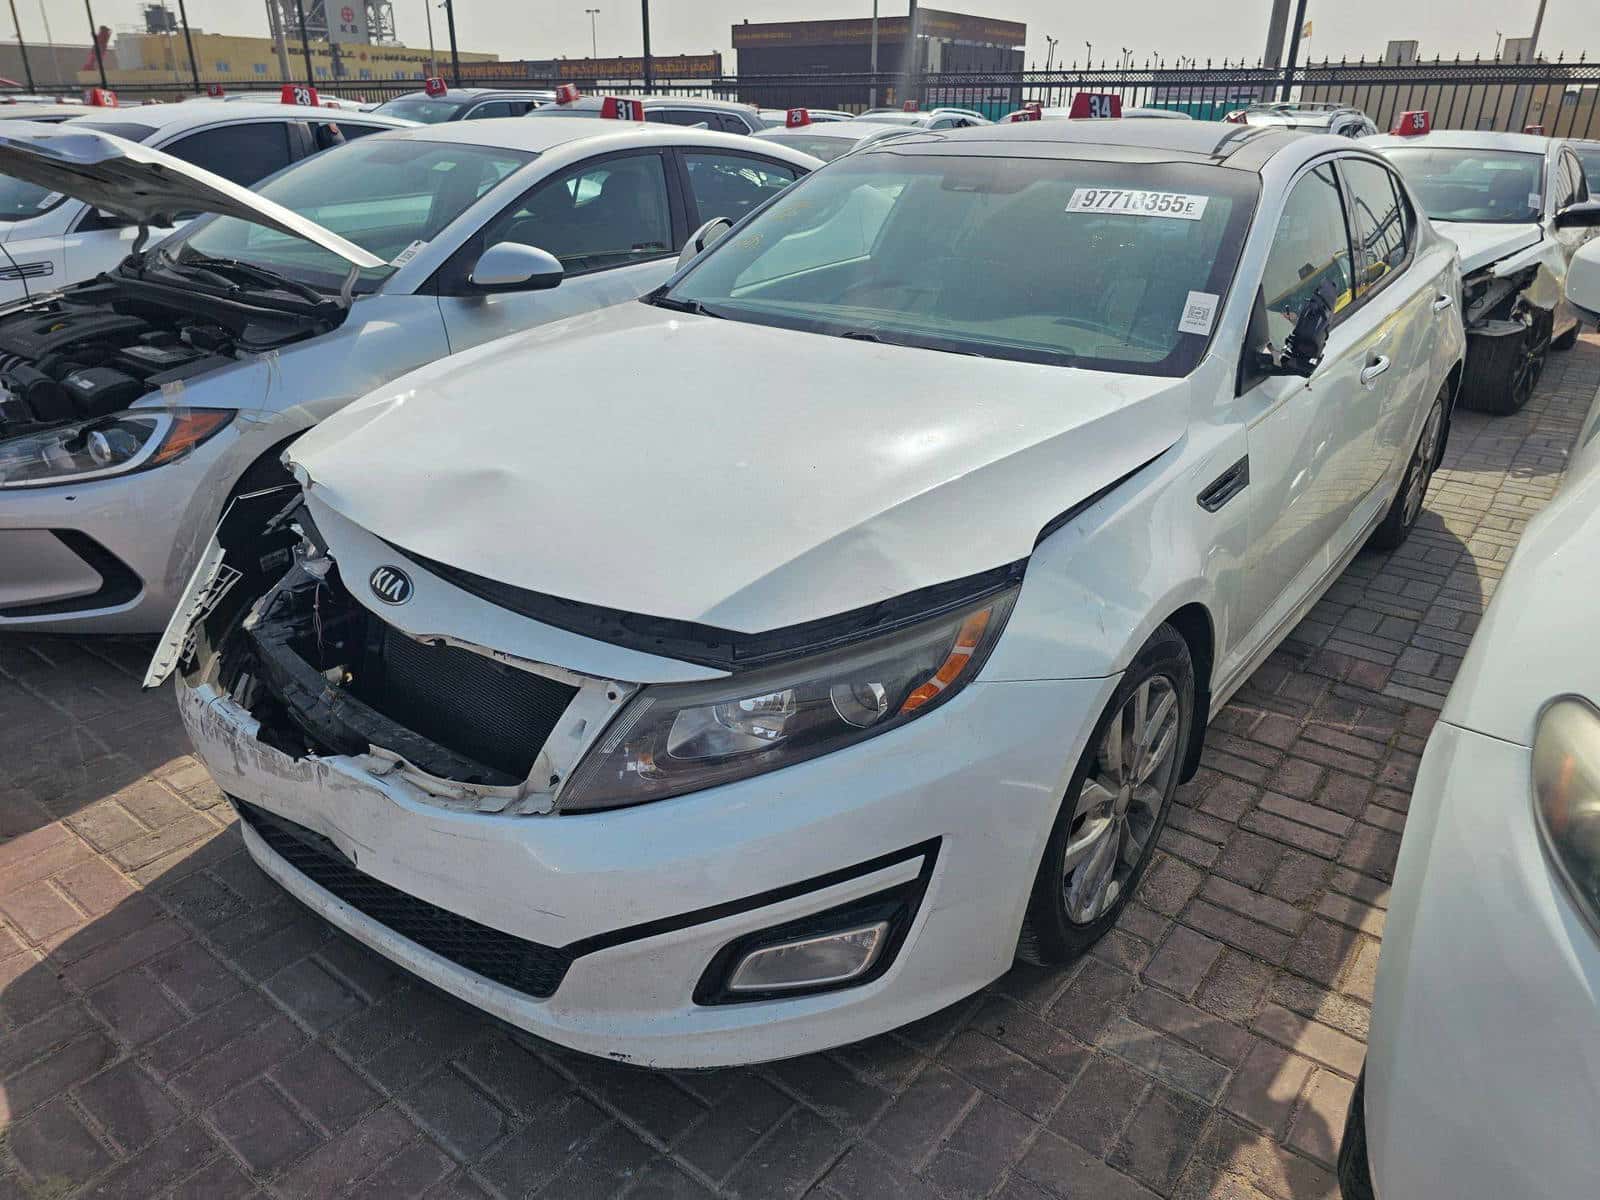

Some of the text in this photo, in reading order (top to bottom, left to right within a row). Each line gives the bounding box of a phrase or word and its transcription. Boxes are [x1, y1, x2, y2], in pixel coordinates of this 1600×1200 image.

[294, 87, 312, 106] 28
[616, 101, 634, 120] 31
[1089, 95, 1112, 118] 34
[1413, 113, 1425, 129] 35
[372, 567, 404, 601] KIA
